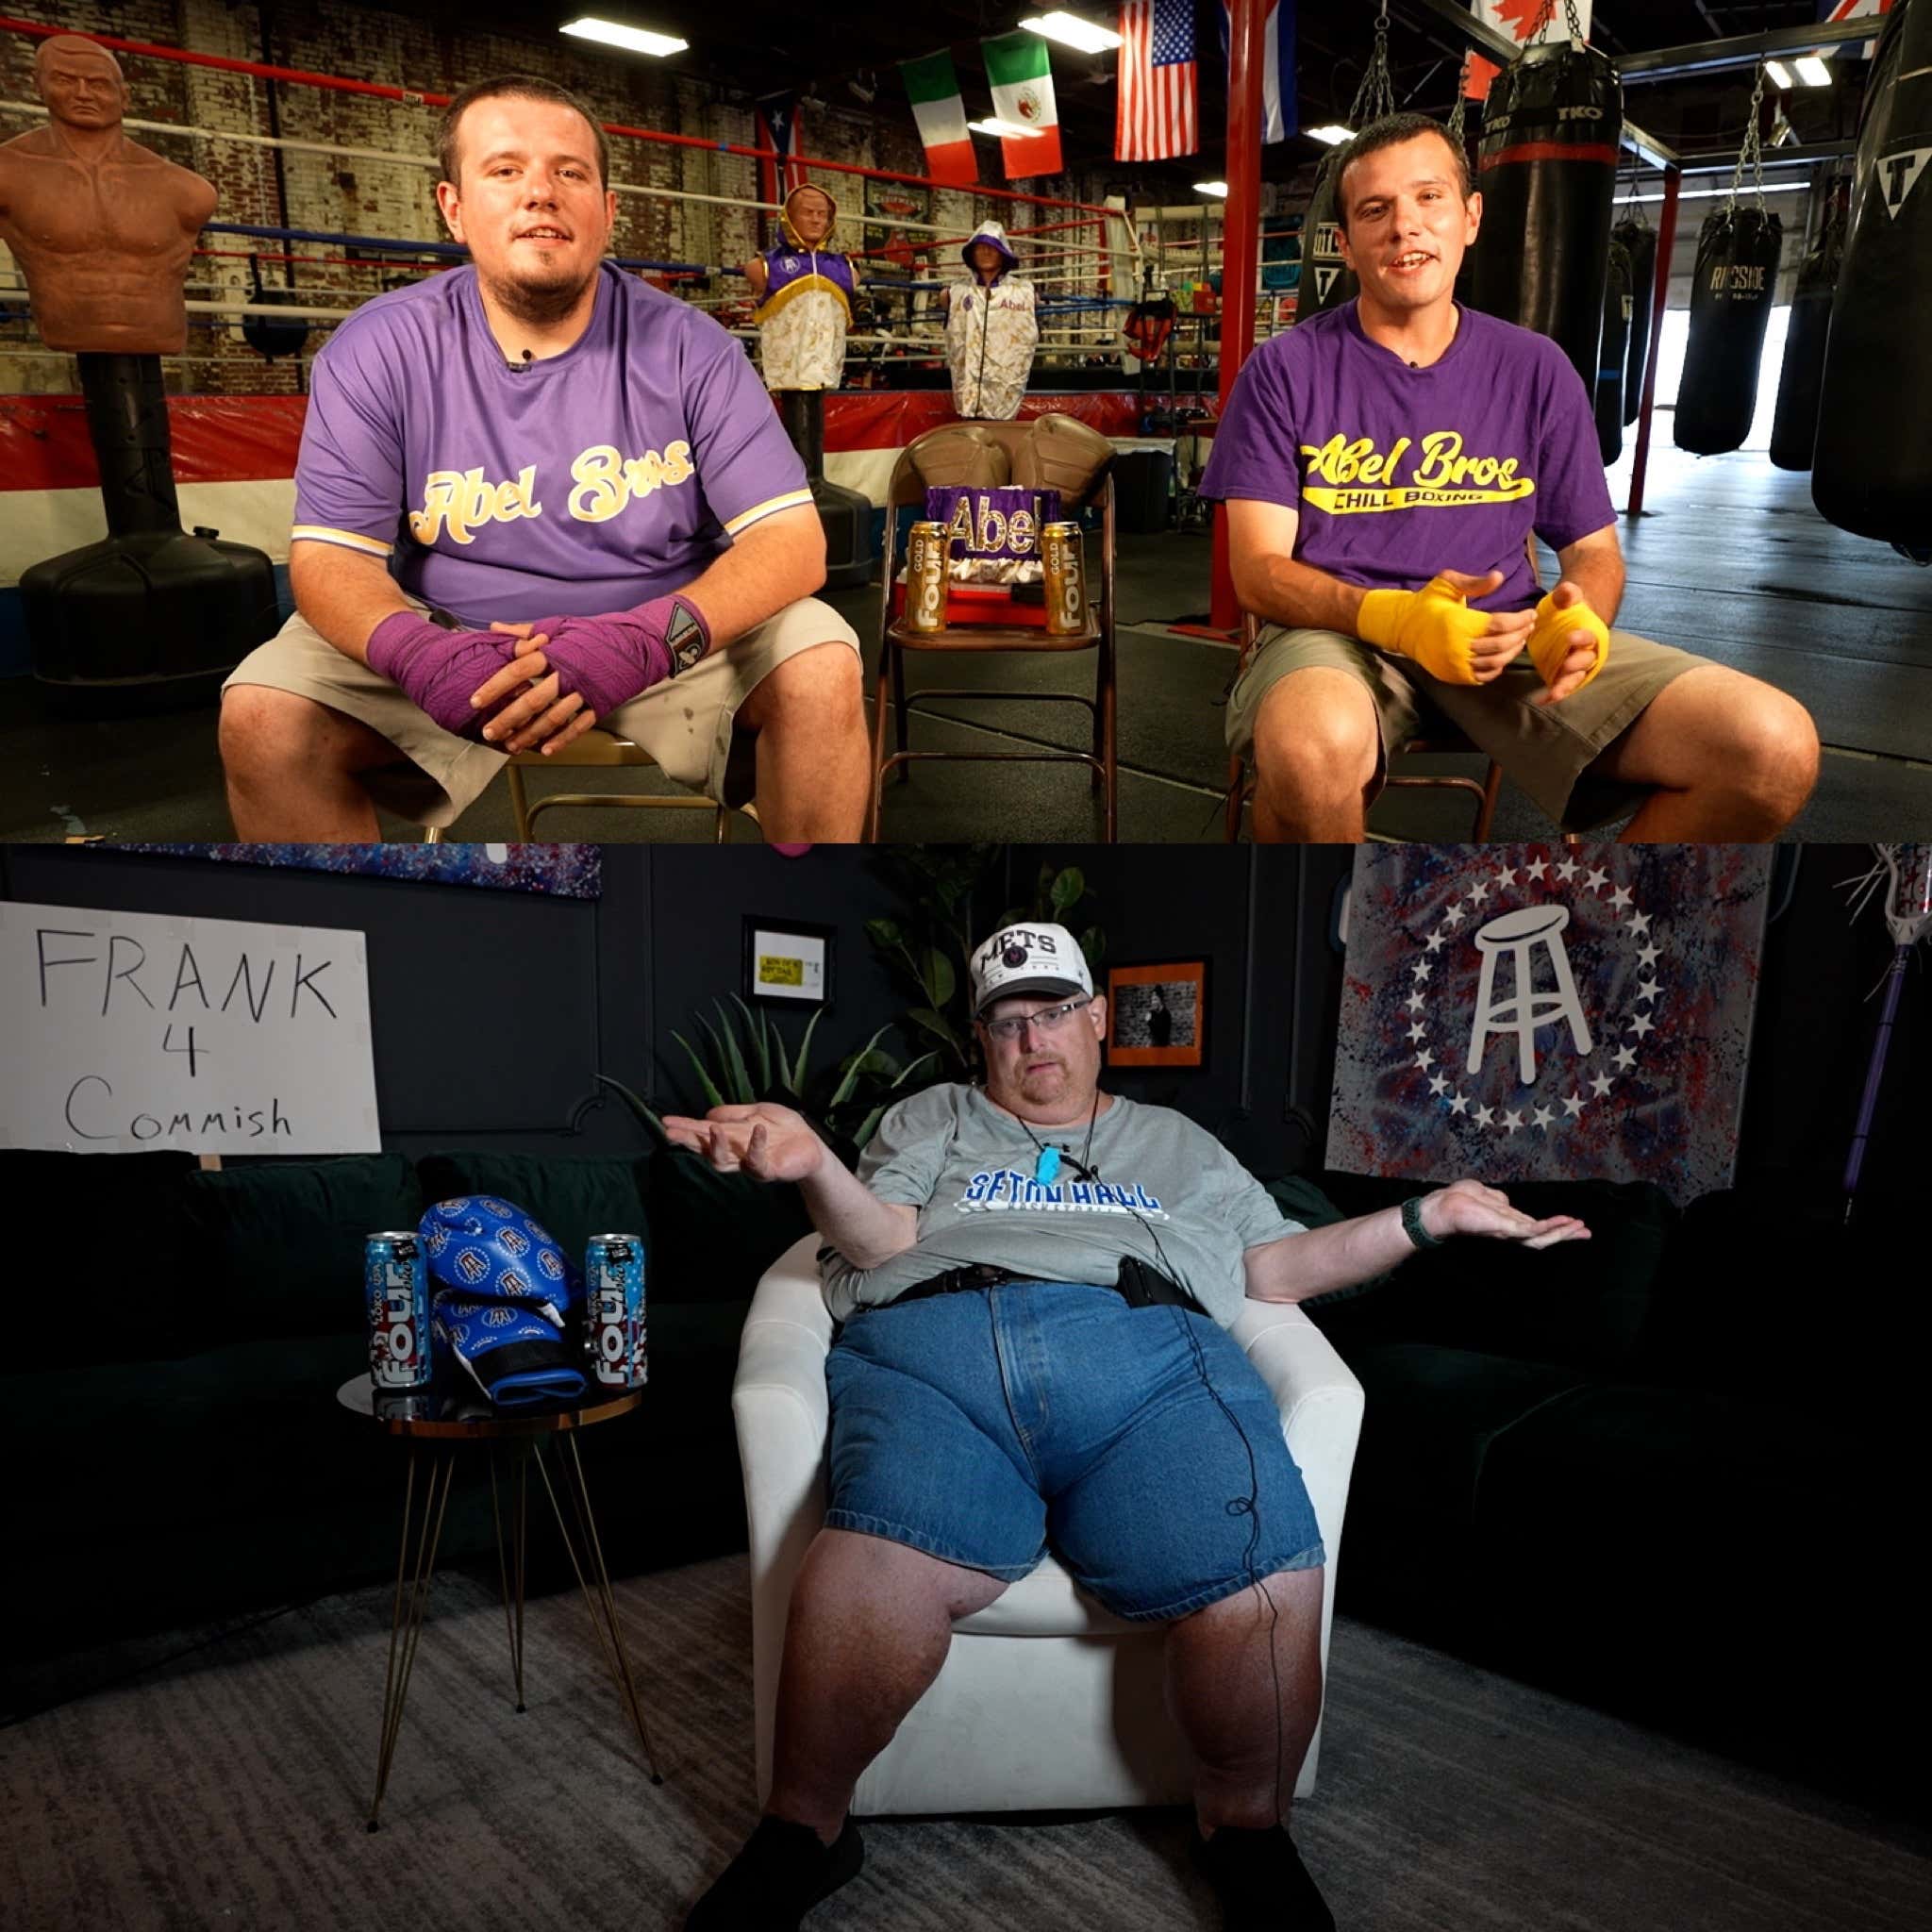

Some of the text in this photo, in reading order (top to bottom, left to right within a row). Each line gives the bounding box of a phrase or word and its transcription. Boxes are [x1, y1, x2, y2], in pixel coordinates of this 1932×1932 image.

[1484, 115, 1510, 135] TKO
[1557, 106, 1604, 122] TKO
[1709, 265, 1767, 291] RIGSIDE
[999, 297, 1025, 311] Abel
[1299, 430, 1524, 490] Abel Bros
[408, 463, 541, 545] Abel
[1333, 490, 1484, 509] CHILL BOXING
[950, 495, 1041, 555] Abel
[913, 539, 924, 573] GOLD
[1049, 541, 1060, 575] GOLD
[979, 929, 1058, 979] METS
[36, 928, 338, 1024] FRANK
[161, 1023, 211, 1077] 4
[1069, 1180, 1162, 1210] HALL
